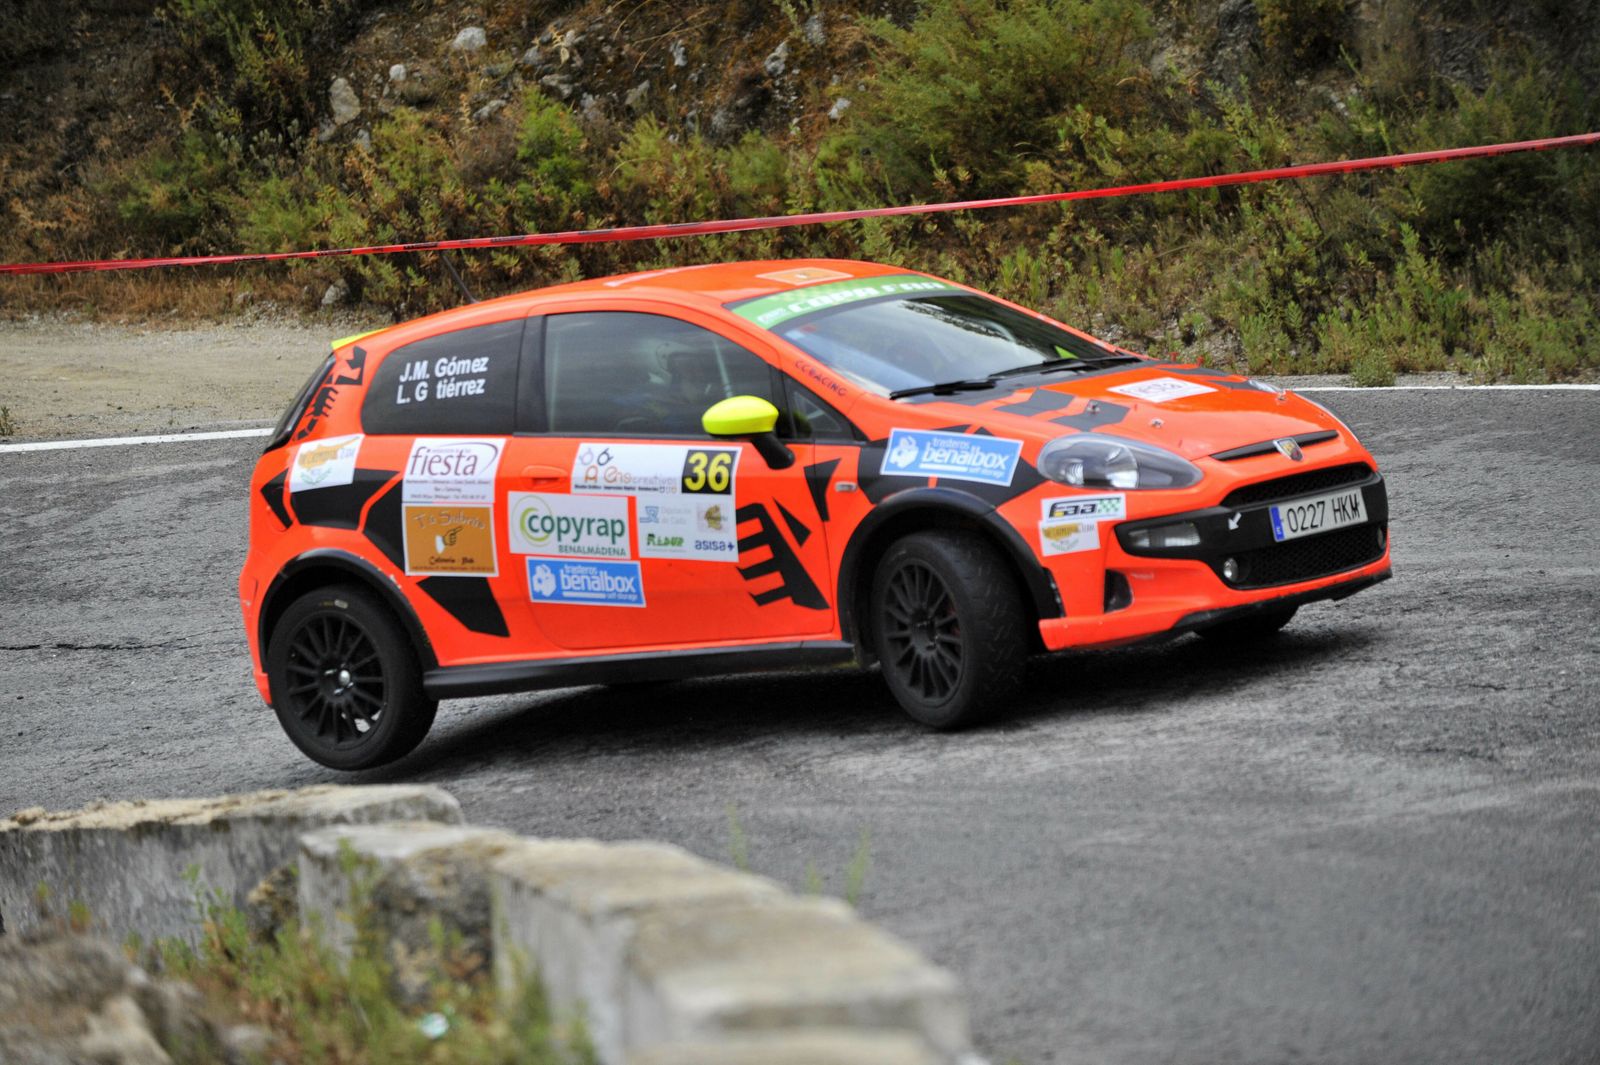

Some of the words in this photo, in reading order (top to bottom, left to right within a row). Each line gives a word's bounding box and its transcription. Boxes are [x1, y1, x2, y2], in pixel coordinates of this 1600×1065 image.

[399, 360, 430, 382] J.M.
[434, 356, 490, 378] Gómez
[396, 384, 411, 404] L.
[409, 446, 479, 476] fiesta
[920, 441, 1010, 471] benalbox
[684, 452, 732, 492] 36
[526, 513, 626, 544] copyrap
[1286, 501, 1326, 533] 0227
[694, 539, 726, 551] asisa
[559, 569, 637, 593] benalbox
